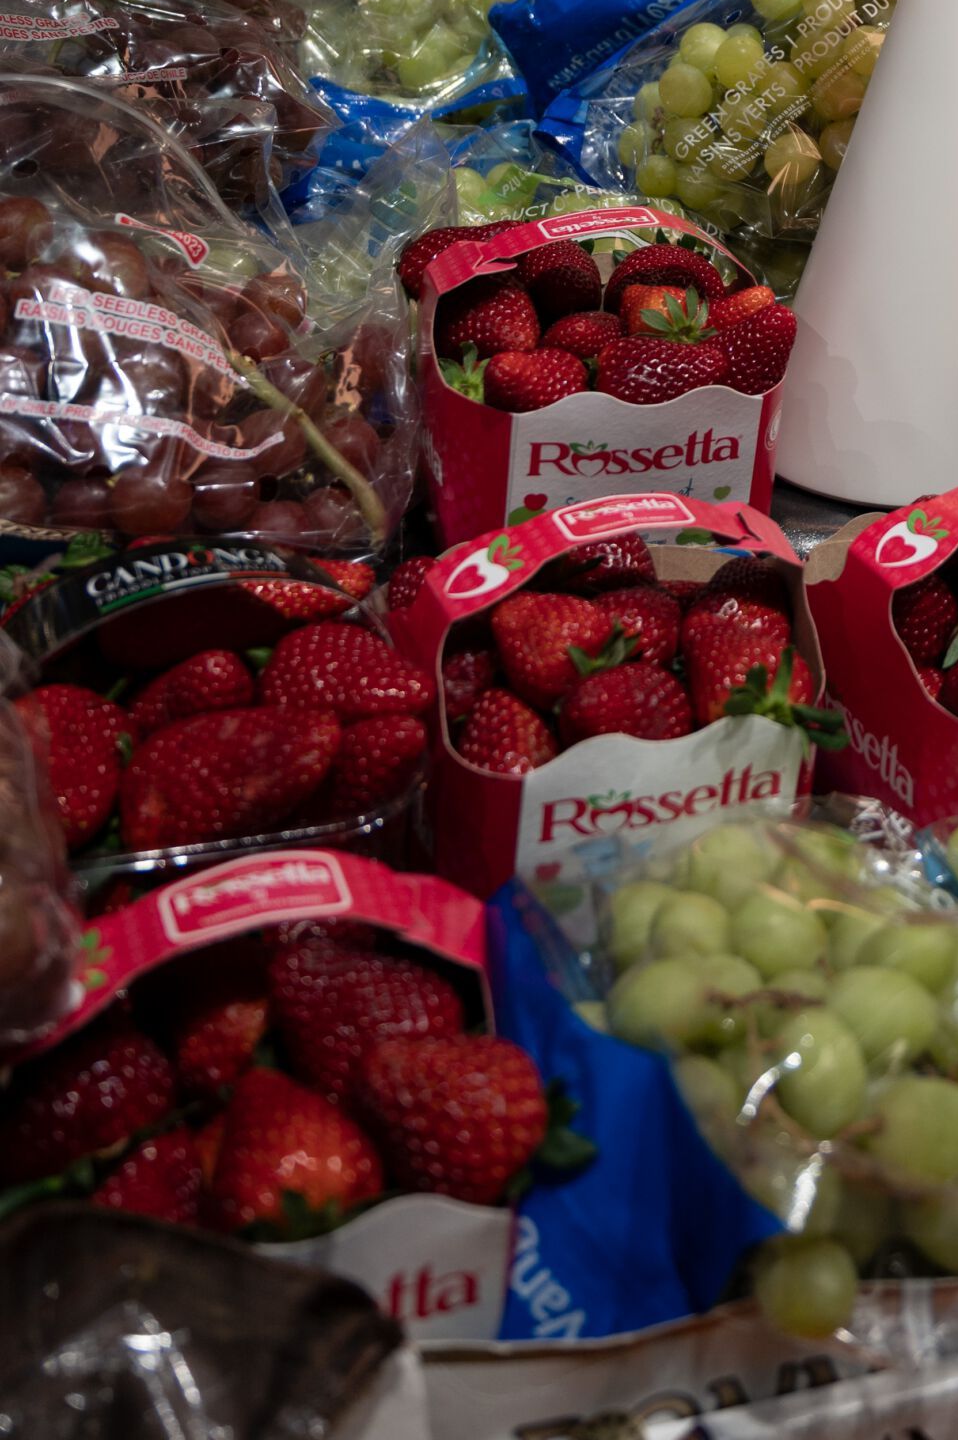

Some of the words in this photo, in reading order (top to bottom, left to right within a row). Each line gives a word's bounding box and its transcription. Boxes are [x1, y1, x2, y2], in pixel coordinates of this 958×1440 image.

[31, 30, 68, 40] SANS
[147, 70, 159, 80] DE
[160, 68, 186, 79] CHILE
[736, 81, 787, 128] VERTS
[793, 11, 867, 74] PRODUIT
[675, 104, 729, 159] GREEN
[725, 45, 786, 106] GRAPES
[93, 295, 177, 327] SEEDLESS
[166, 332, 204, 358] SANS
[526, 427, 741, 478] Rossetta
[538, 762, 784, 842] Rossetta
